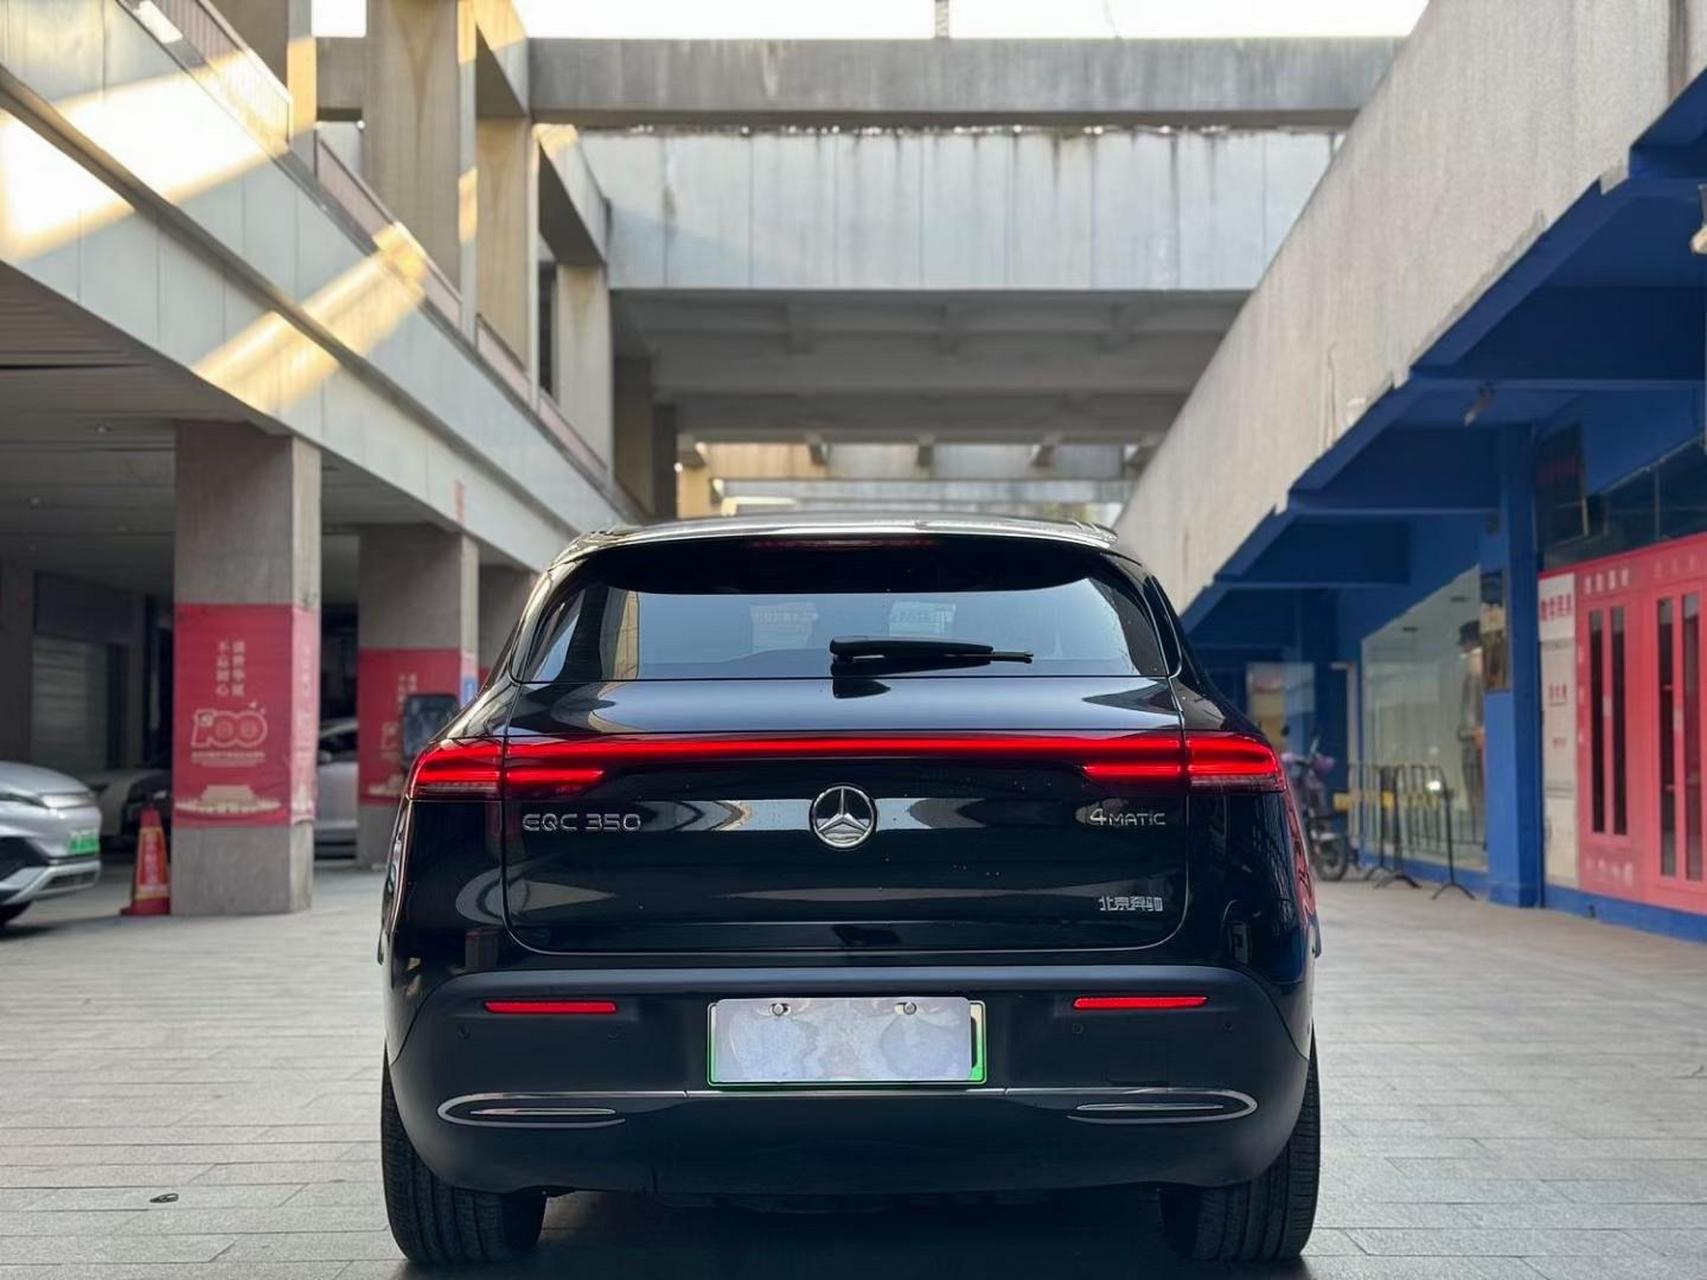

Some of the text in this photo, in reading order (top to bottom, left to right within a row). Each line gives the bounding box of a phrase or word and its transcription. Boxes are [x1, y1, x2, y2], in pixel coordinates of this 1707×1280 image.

[522, 813, 641, 832] EQC 350
[1089, 808, 1167, 826] 4MATIC
